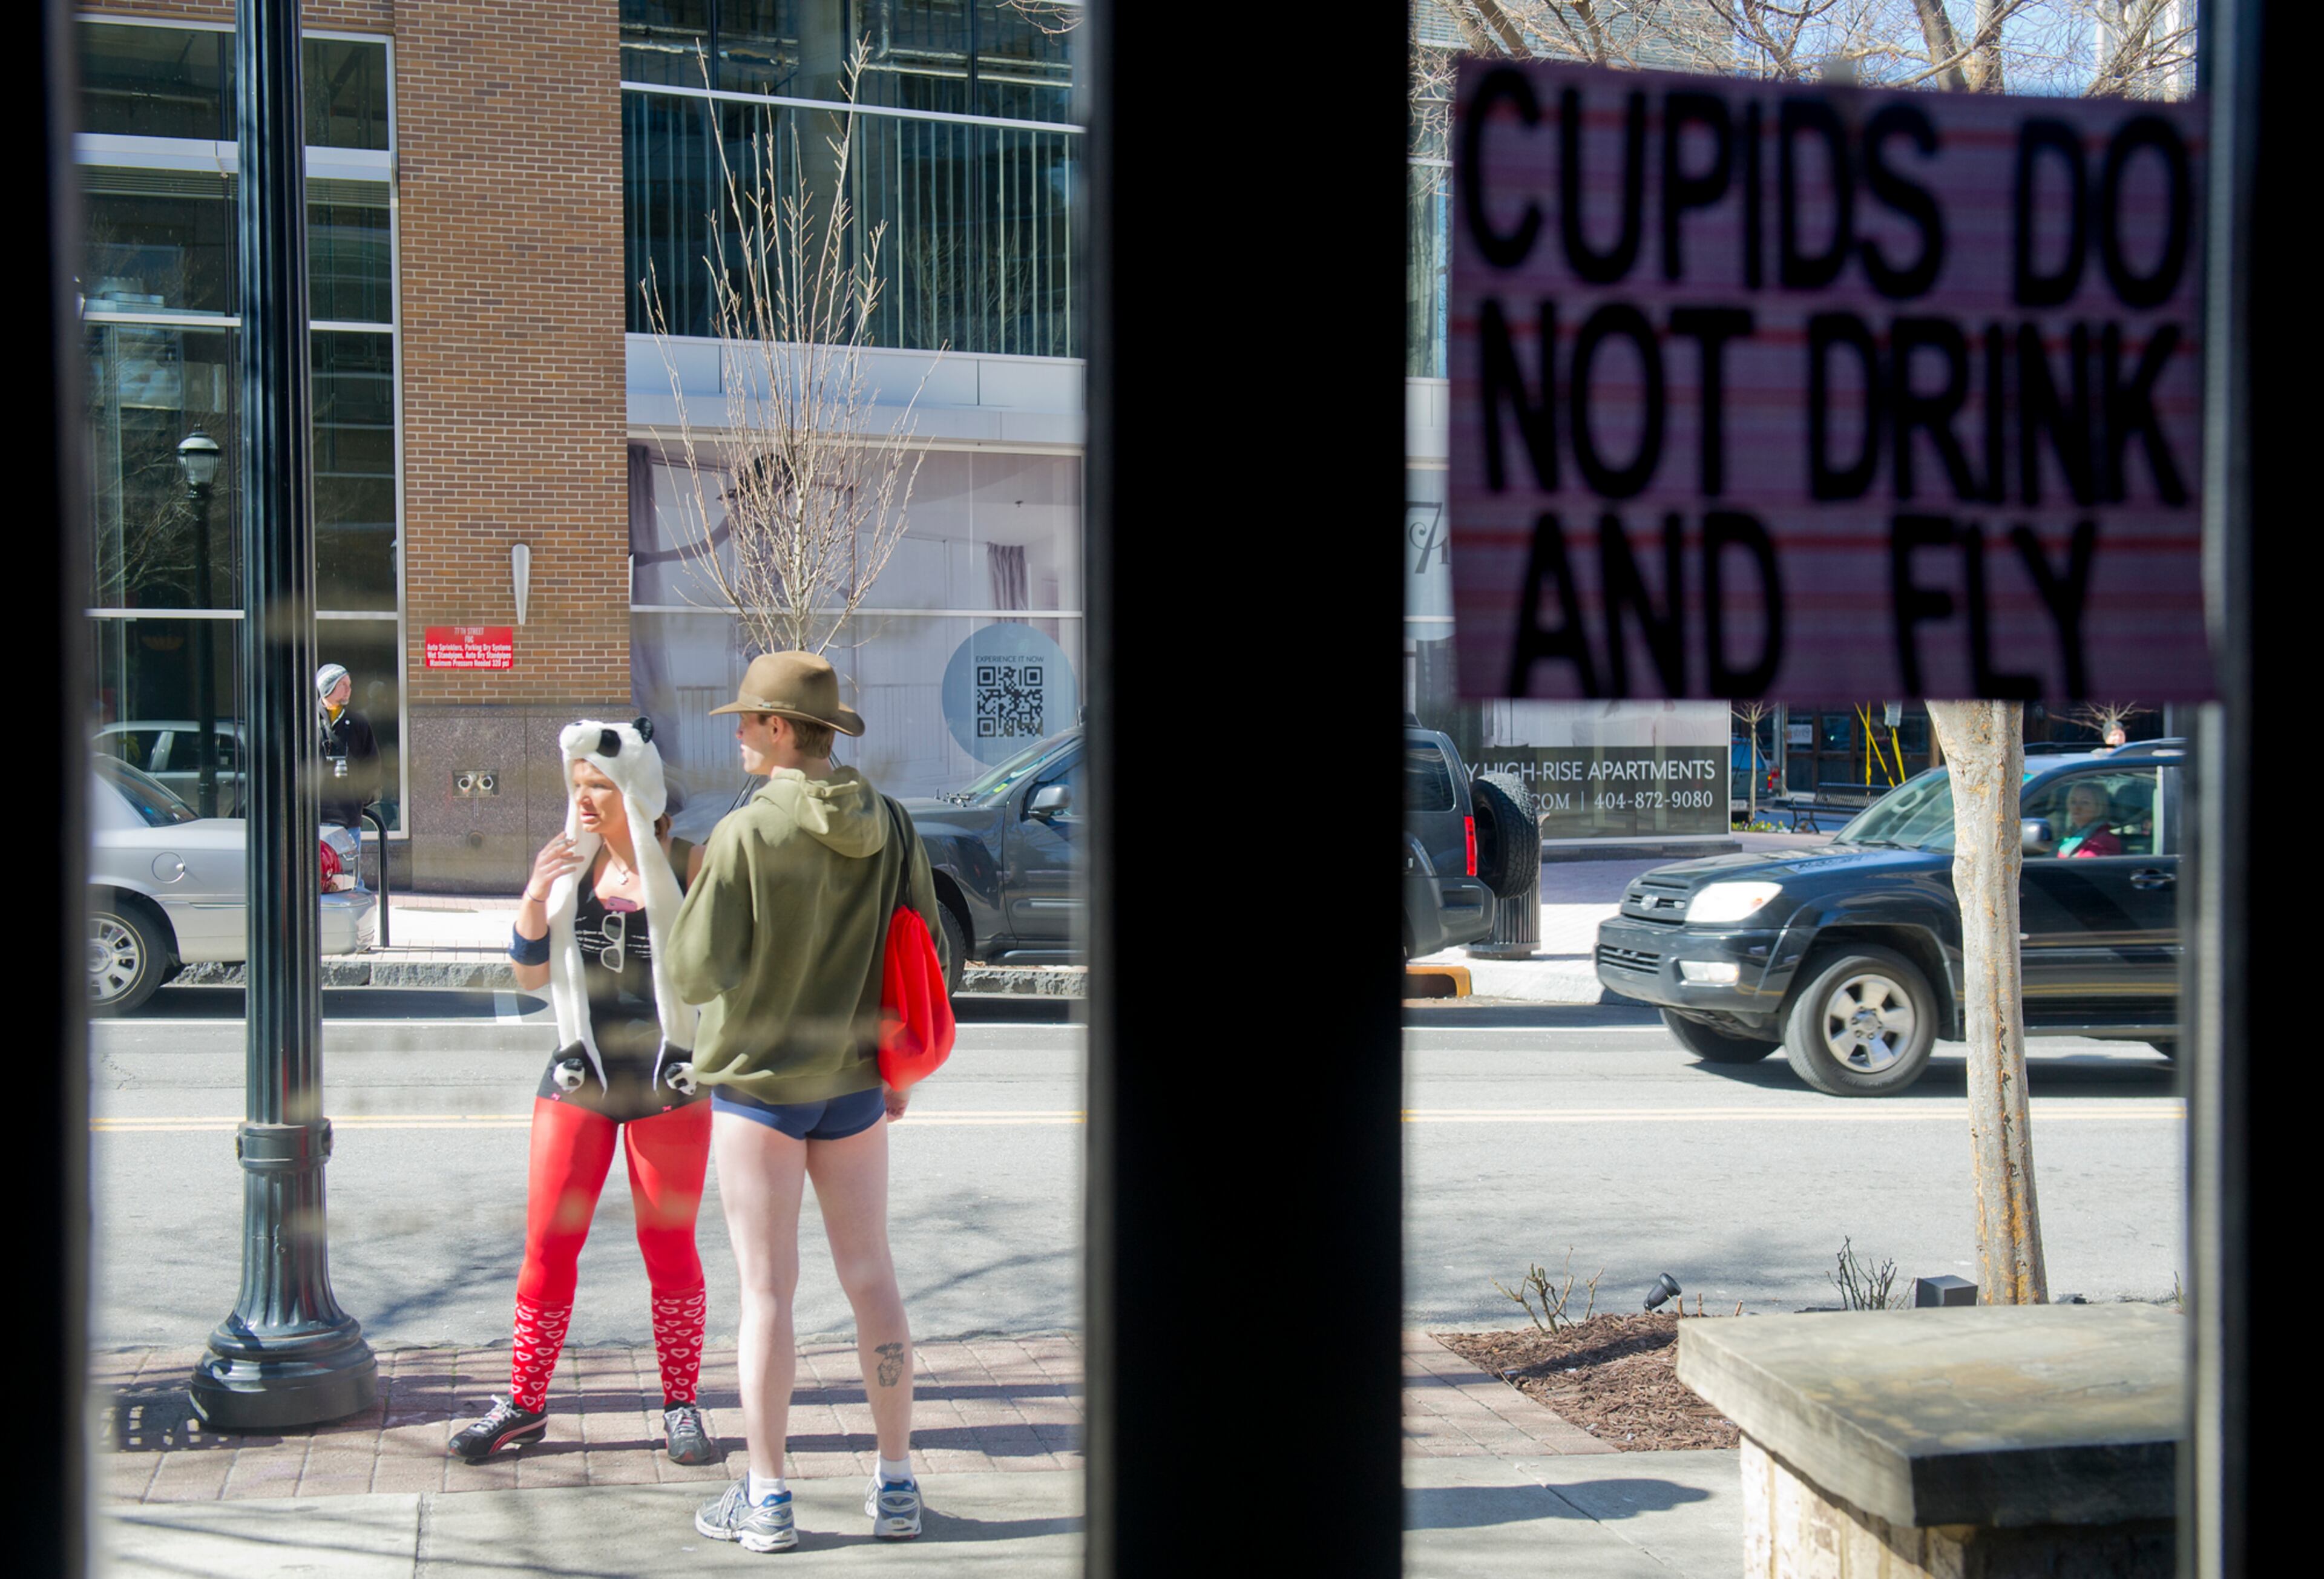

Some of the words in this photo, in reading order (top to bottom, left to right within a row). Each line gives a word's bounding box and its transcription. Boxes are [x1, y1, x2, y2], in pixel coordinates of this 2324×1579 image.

[1460, 65, 1944, 301] CUPIDS
[2014, 114, 2191, 309] DO
[1477, 297, 1755, 499] NOT
[1805, 310, 2187, 509] DRINK
[1507, 510, 1785, 699] AND
[1891, 513, 2099, 701] FLY
[1484, 761, 1583, 782] HIGH-RISE
[1587, 759, 1716, 781] APARTMENTS
[1594, 790, 1713, 809] 404-872-9080
